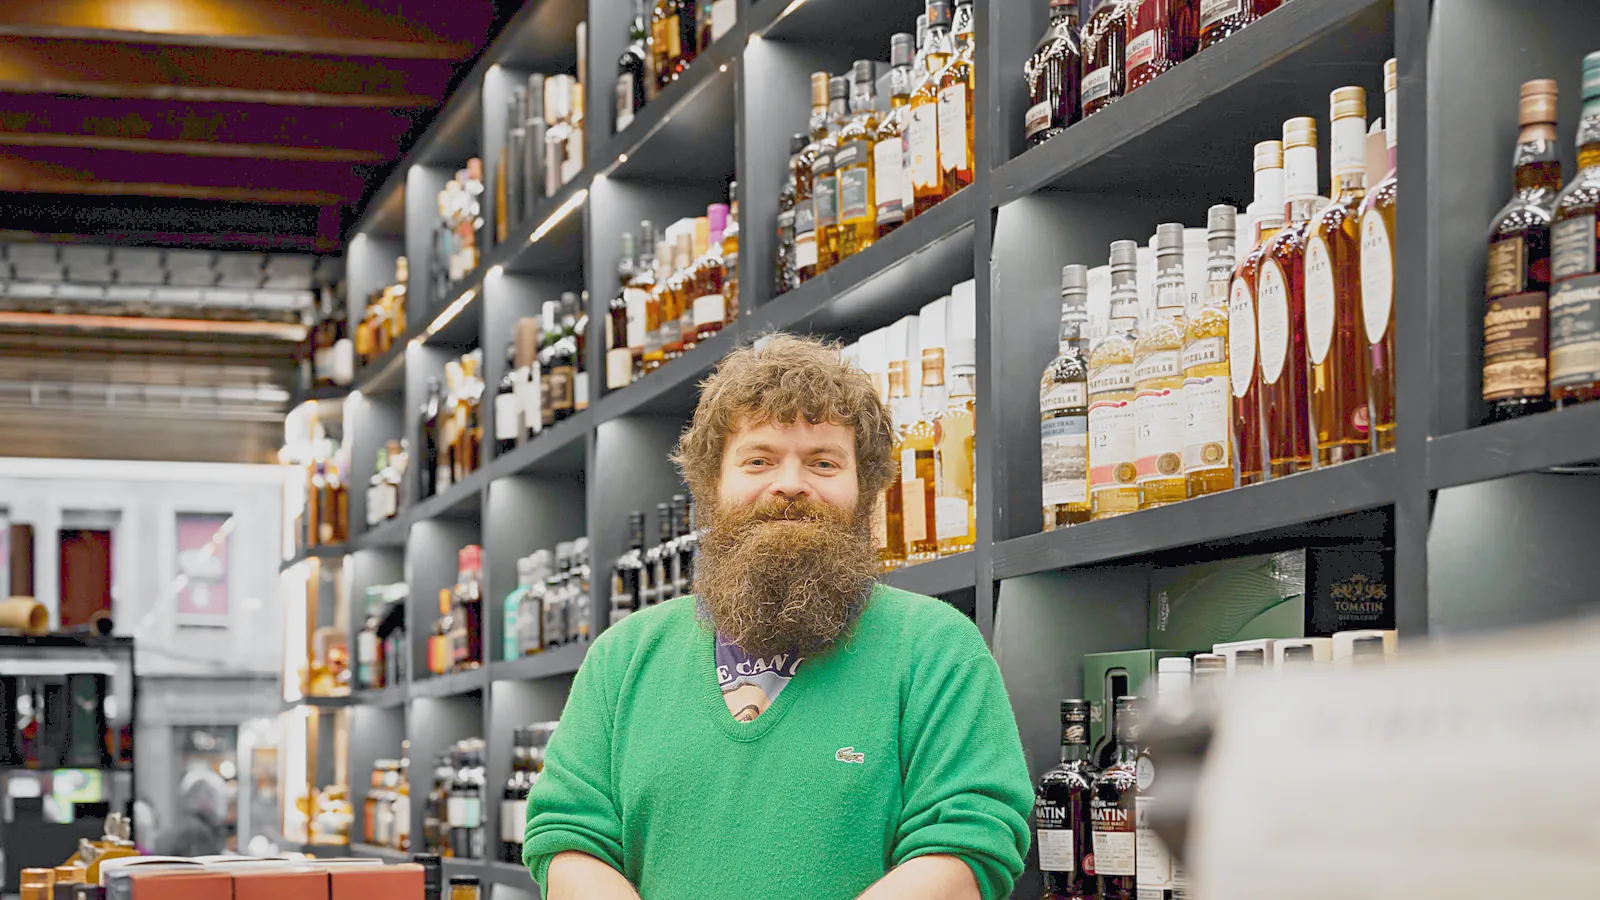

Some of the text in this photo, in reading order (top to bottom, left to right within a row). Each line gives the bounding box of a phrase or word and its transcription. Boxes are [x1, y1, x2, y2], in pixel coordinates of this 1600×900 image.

[1094, 432, 1107, 449] 12
[1335, 601, 1384, 612] TOMATIN
[736, 653, 789, 674] CAN
